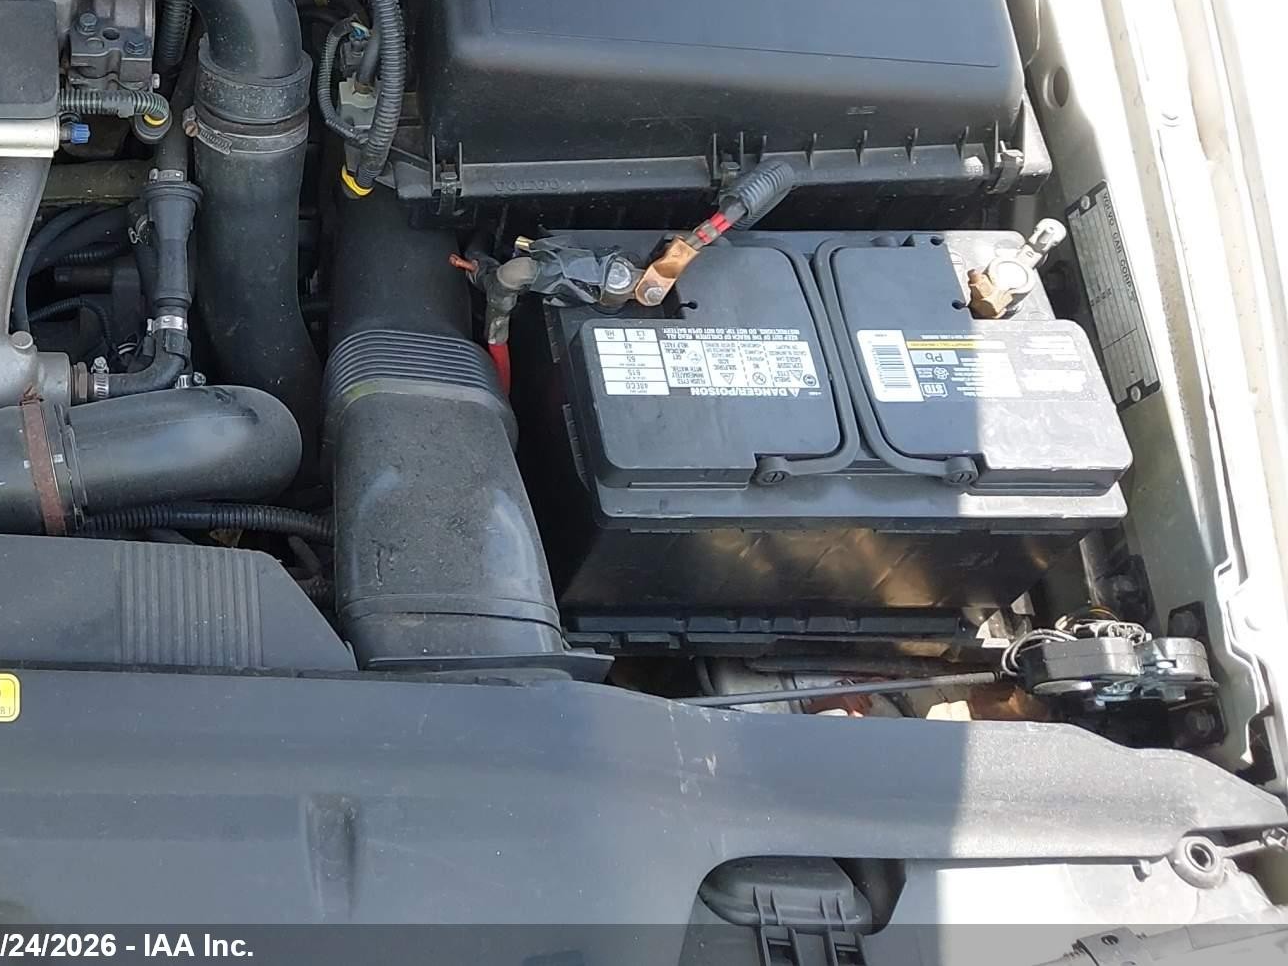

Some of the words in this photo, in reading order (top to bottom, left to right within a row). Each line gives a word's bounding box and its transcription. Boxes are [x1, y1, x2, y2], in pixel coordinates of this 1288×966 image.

[1101, 191, 1115, 227] VOLVO
[1111, 230, 1122, 255] CAR
[925, 352, 943, 362] Pb
[691, 387, 787, 397] DANGER/POISON
